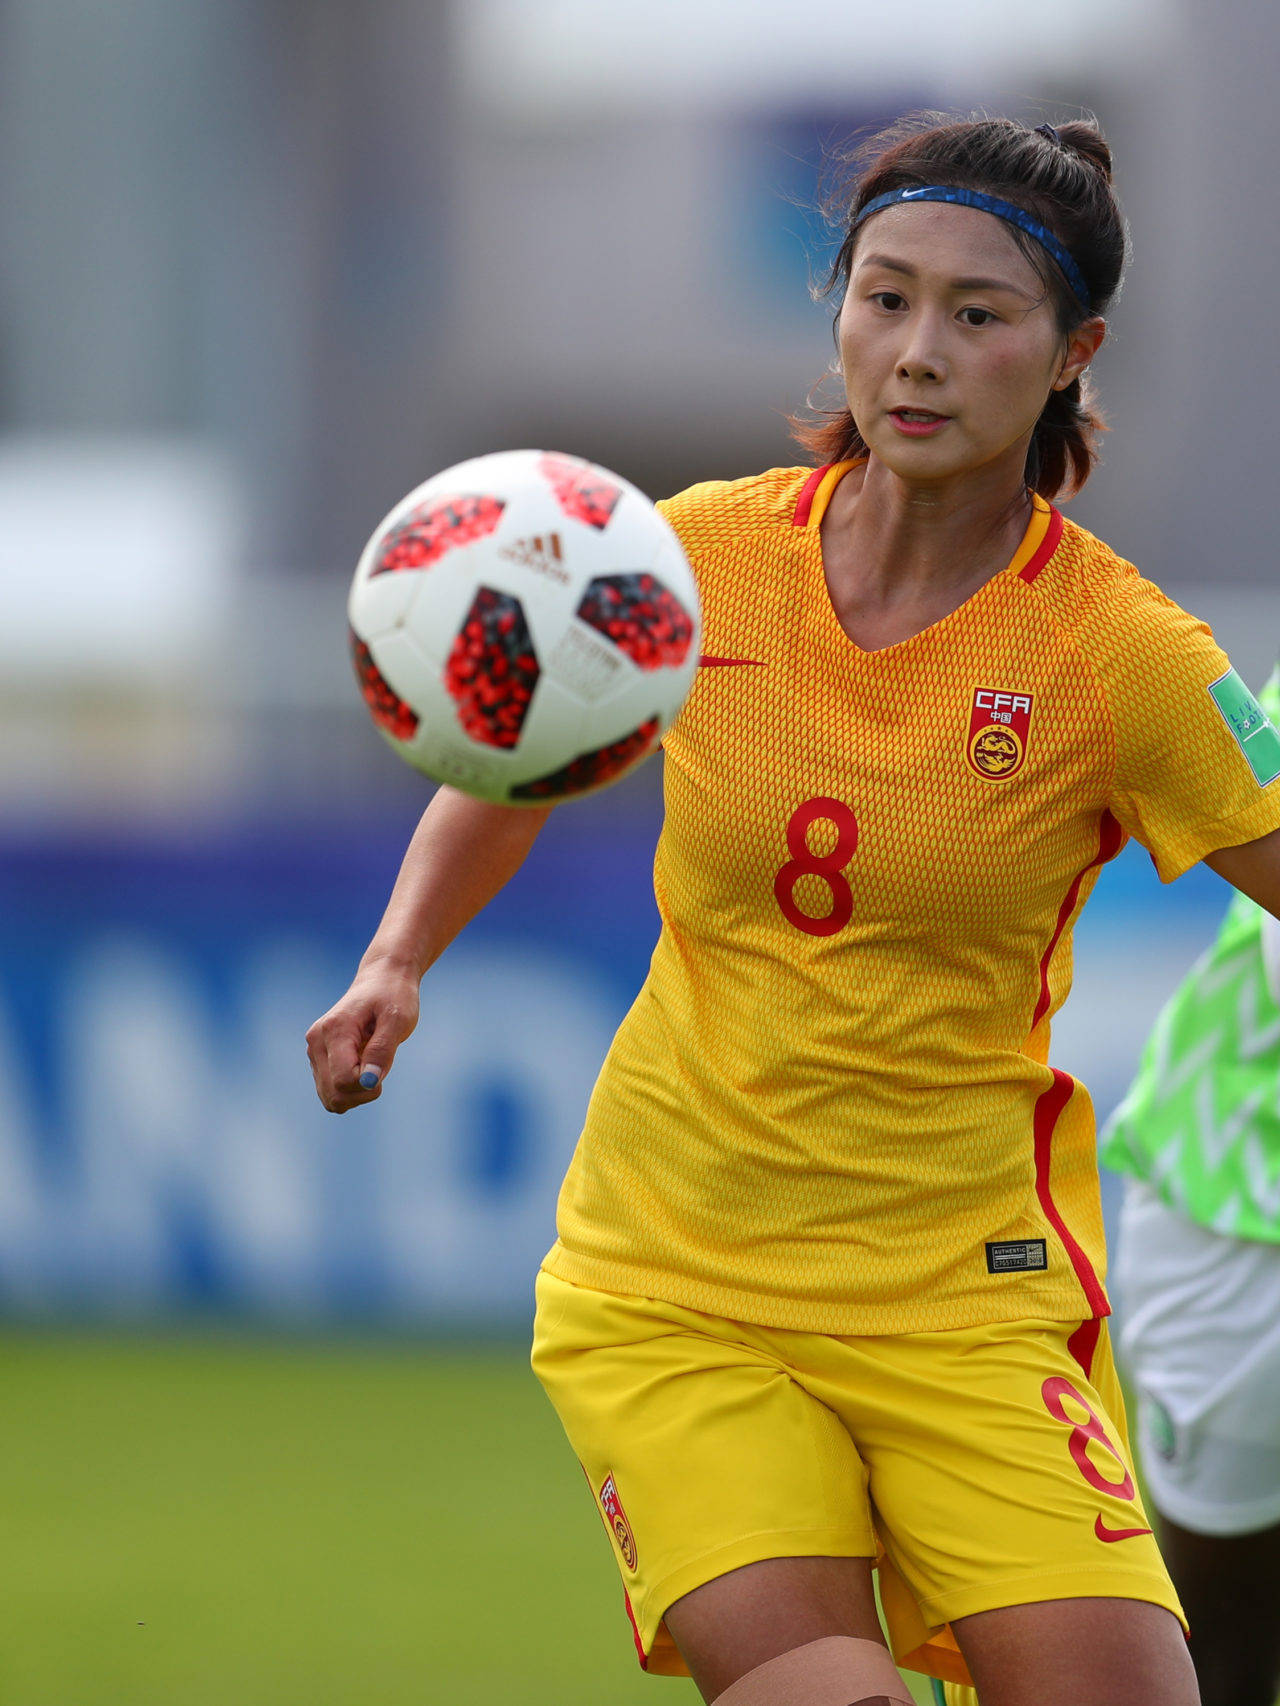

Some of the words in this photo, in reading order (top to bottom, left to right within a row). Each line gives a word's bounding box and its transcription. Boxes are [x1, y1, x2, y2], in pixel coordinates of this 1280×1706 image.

[975, 690, 1031, 715] CFA
[990, 710, 1012, 724] 中国
[774, 796, 858, 937] 8
[994, 1247, 1026, 1255] AUTHENTIC
[1041, 1376, 1135, 1501] 8
